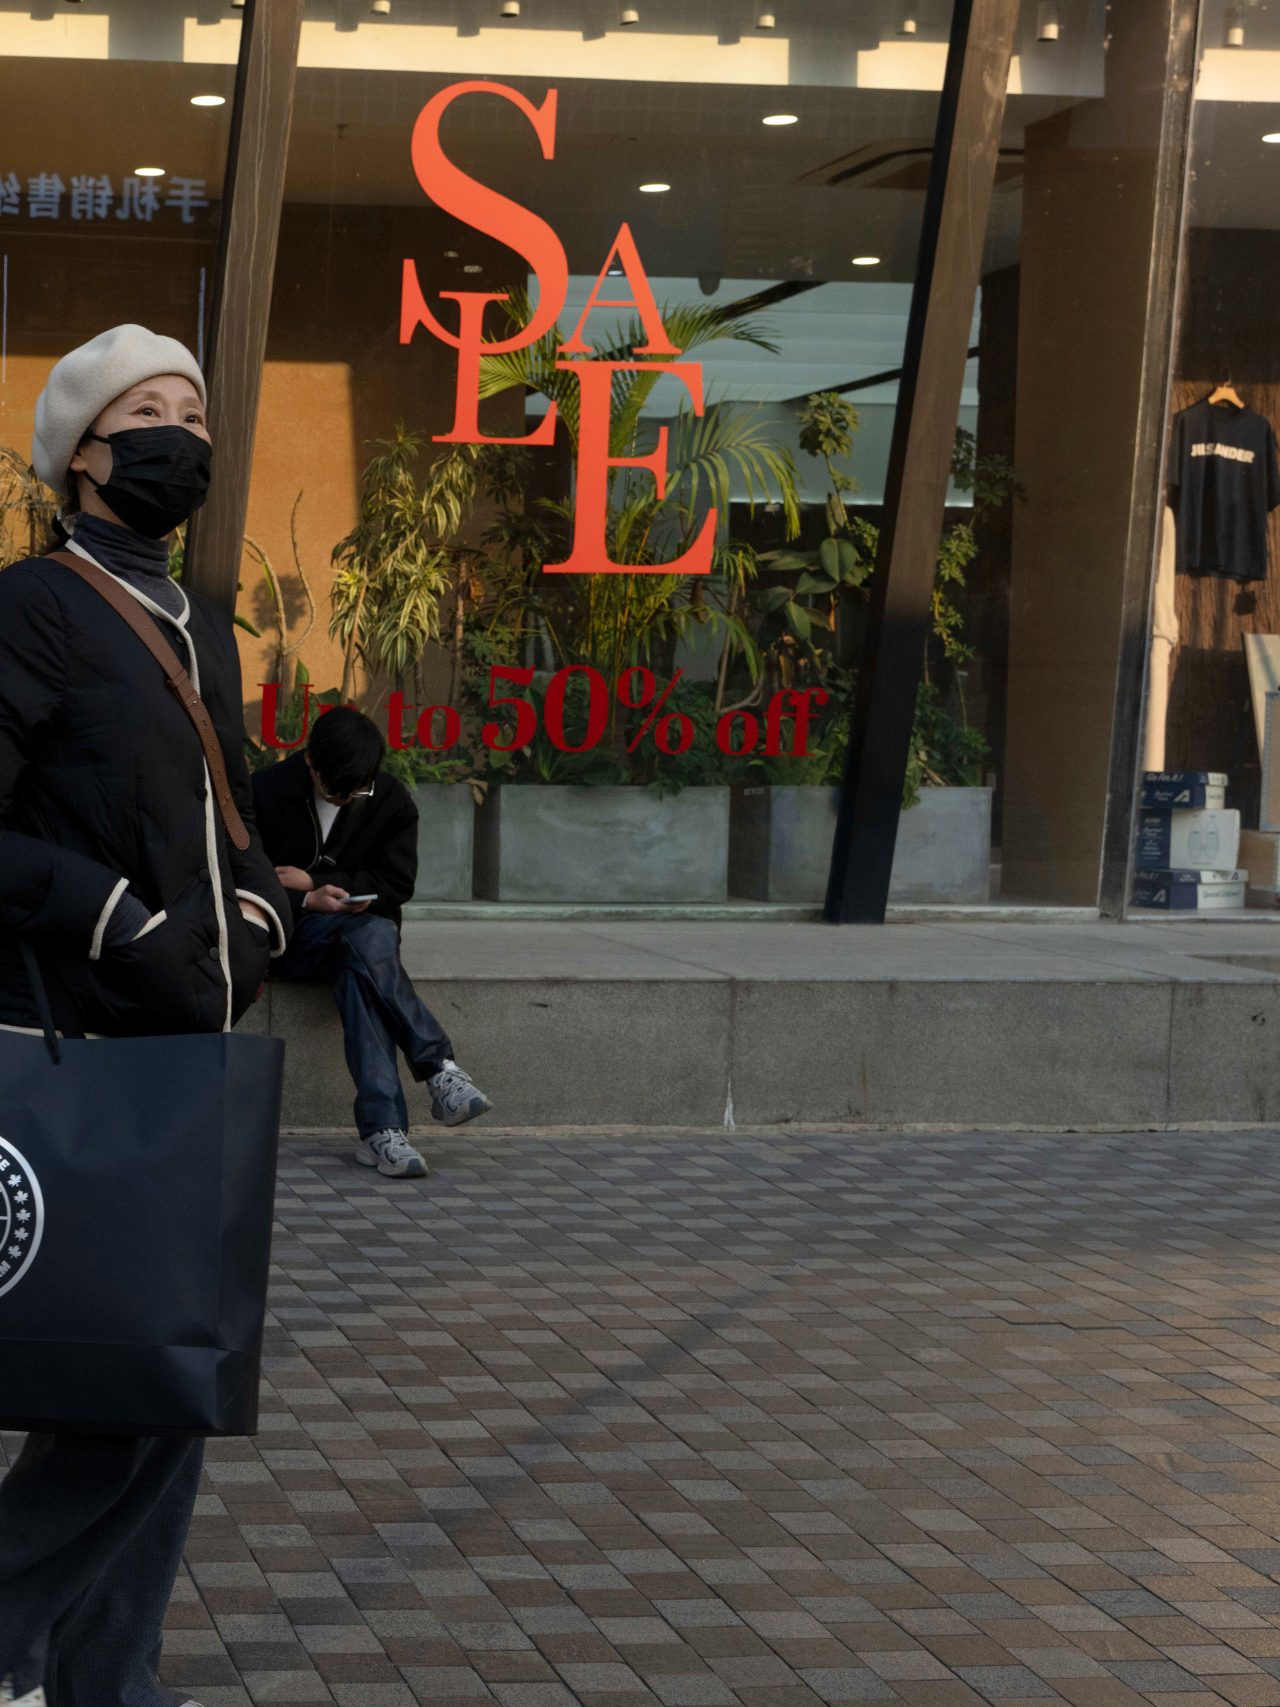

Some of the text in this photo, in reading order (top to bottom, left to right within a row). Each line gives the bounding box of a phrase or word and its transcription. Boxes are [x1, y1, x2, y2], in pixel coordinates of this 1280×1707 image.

[399, 80, 718, 575] SALE
[257, 664, 829, 757] U to 50% off
